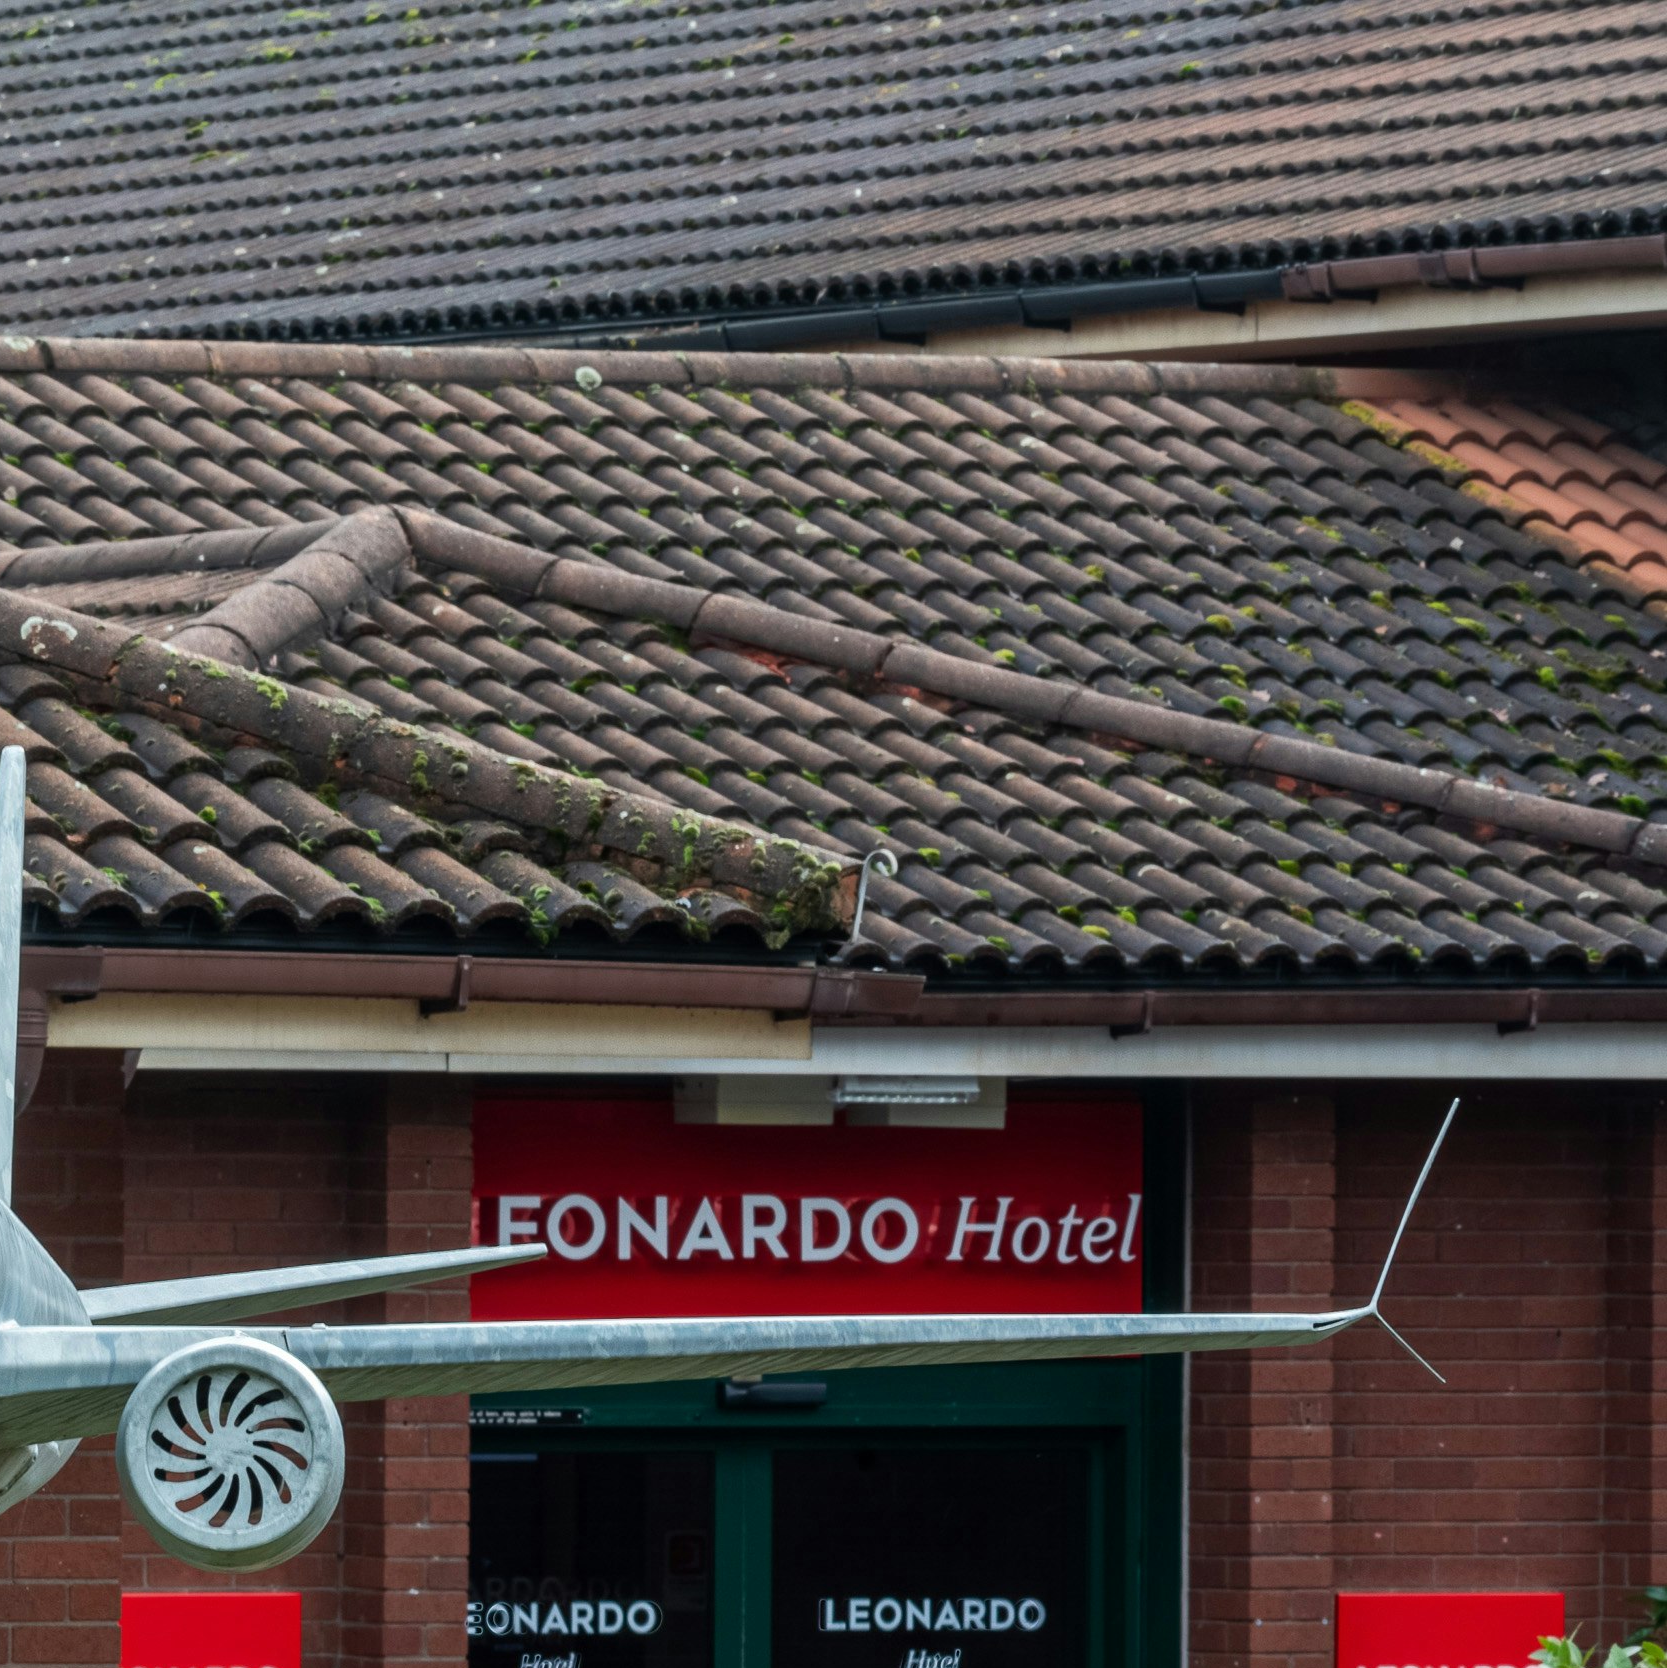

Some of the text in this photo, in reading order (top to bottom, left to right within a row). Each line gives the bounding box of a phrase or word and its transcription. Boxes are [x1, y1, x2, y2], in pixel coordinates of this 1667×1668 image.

[498, 1192, 1142, 1264] EONARDO Hotel
[466, 1600, 663, 1636] EONARDO
[819, 1597, 1046, 1632] LEONARDO
